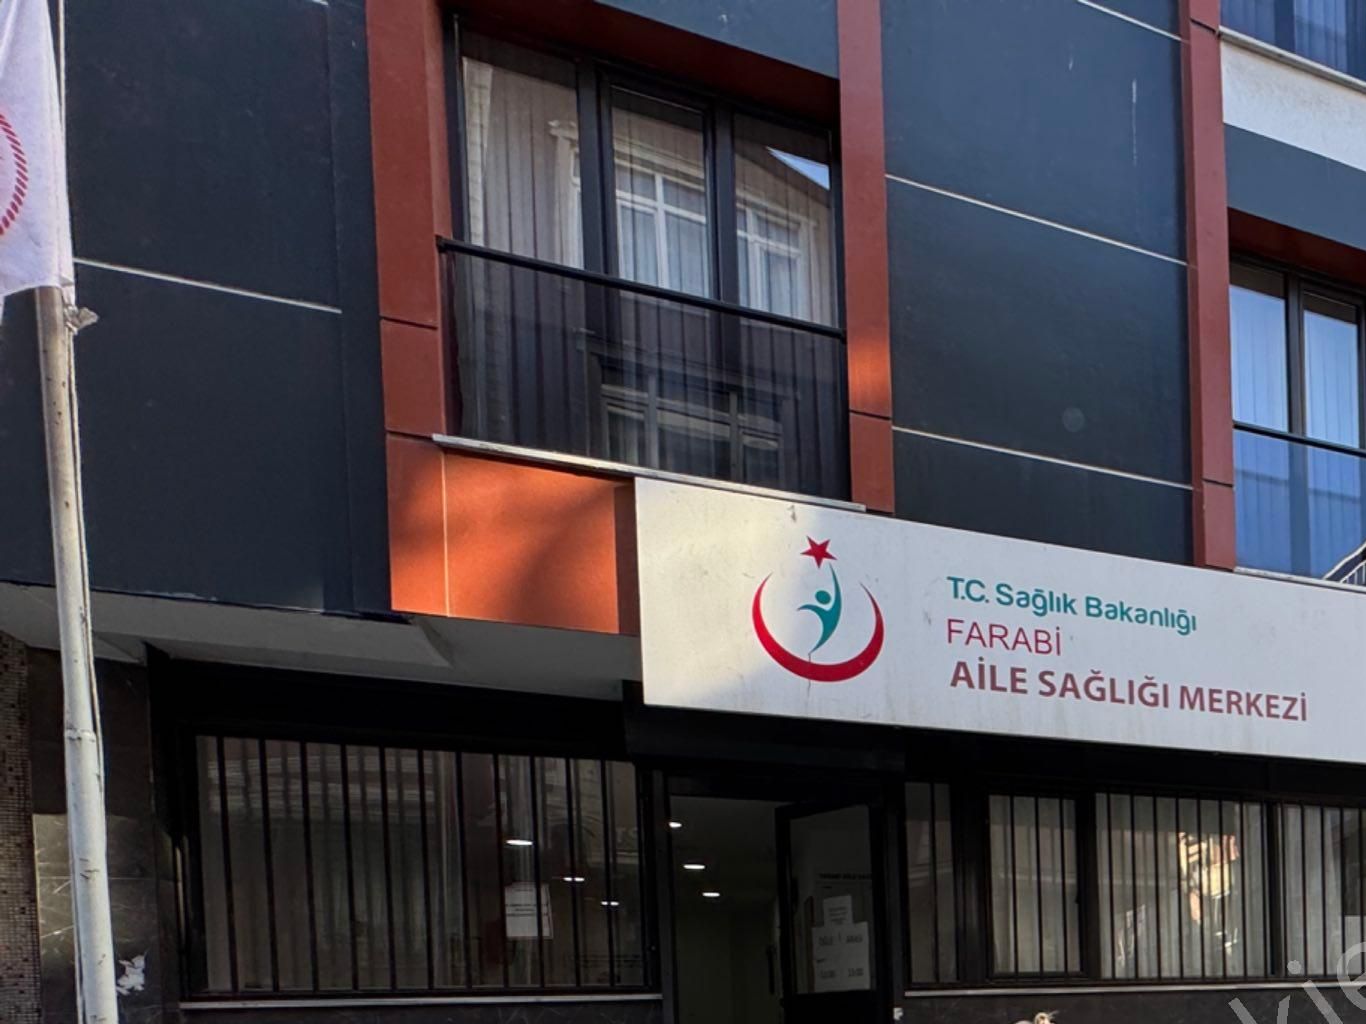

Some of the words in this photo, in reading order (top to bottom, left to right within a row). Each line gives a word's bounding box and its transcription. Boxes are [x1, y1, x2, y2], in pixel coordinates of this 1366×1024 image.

[946, 576, 990, 603] T.C.
[996, 583, 1078, 617] Sağlık
[1085, 595, 1197, 636] Bakanlığı
[947, 618, 1061, 656] FARABİ
[950, 656, 1028, 694] AİLE
[1038, 668, 1169, 709] SAĞLIĞI
[1179, 685, 1307, 722] MERKEZİ
